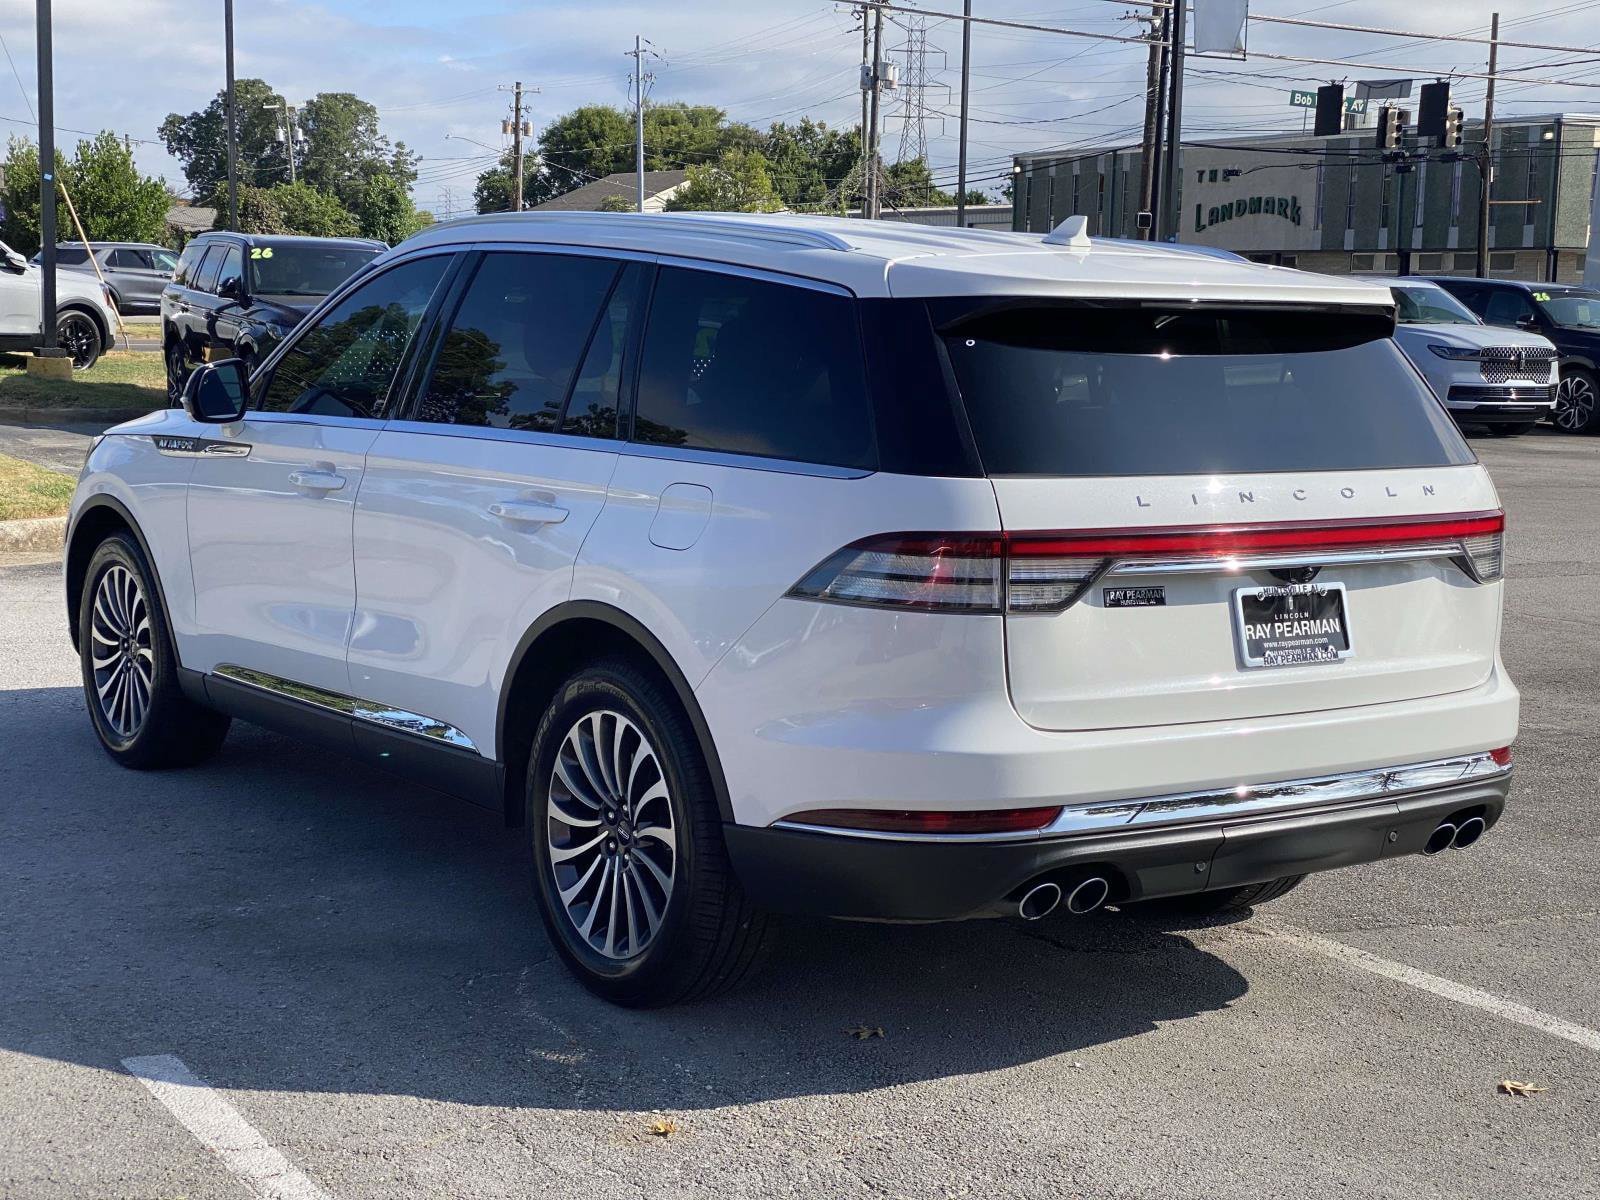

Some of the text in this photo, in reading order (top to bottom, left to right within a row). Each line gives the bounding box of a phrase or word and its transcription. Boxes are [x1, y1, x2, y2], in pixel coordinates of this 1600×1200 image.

[1294, 93, 1312, 105] Bob
[250, 247, 273, 259] 26
[1532, 292, 1551, 302] 26
[1135, 484, 1437, 507] LINCOLN
[1110, 589, 1165, 601] RAY PEARMAN
[1274, 611, 1309, 620] LINCOLN
[1245, 618, 1340, 640] RAY PEARMAN
